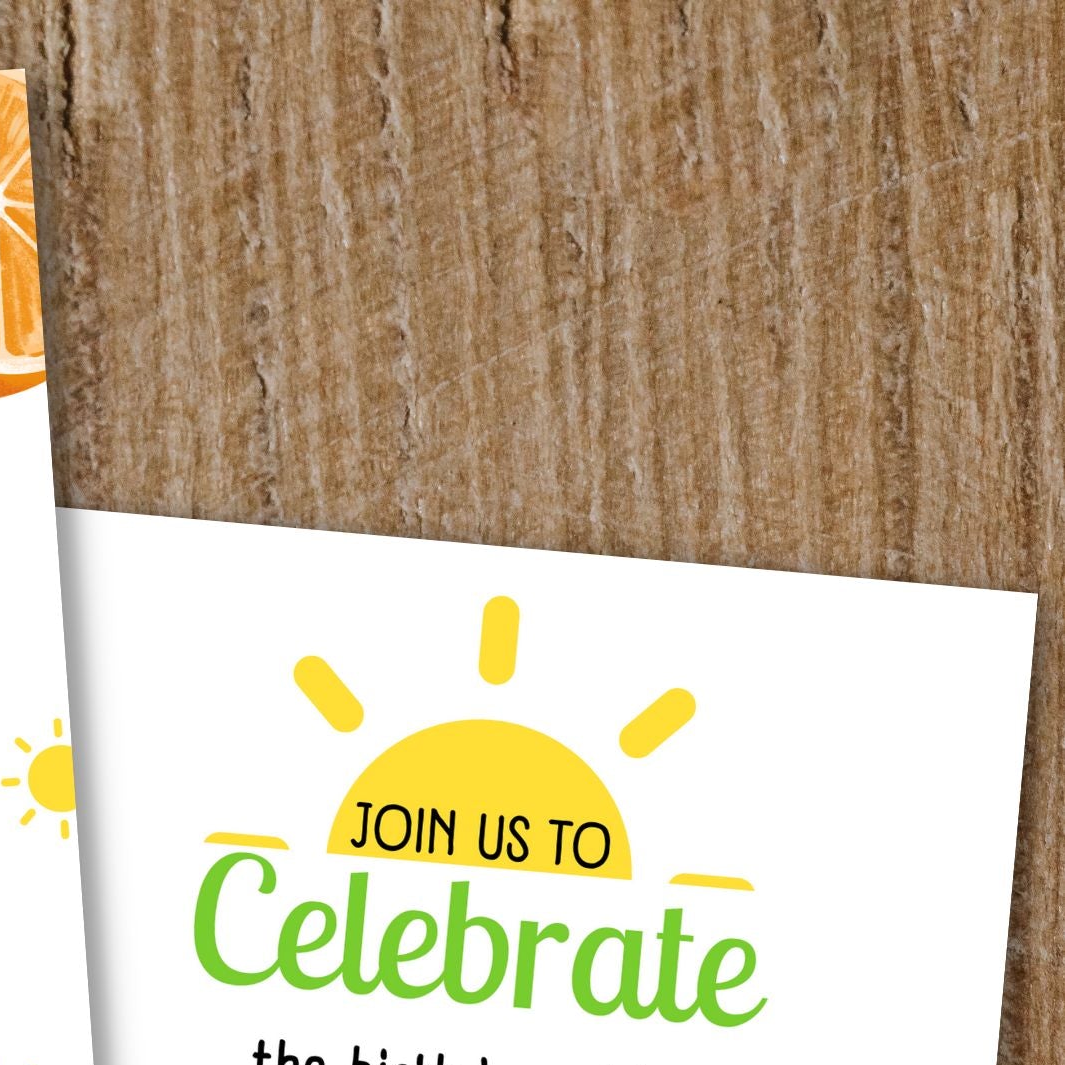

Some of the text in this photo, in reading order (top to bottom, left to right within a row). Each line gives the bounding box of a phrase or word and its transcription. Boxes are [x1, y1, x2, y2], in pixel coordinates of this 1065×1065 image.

[350, 801, 611, 870] JOIN US TO
[194, 852, 767, 1028] Celebrate
